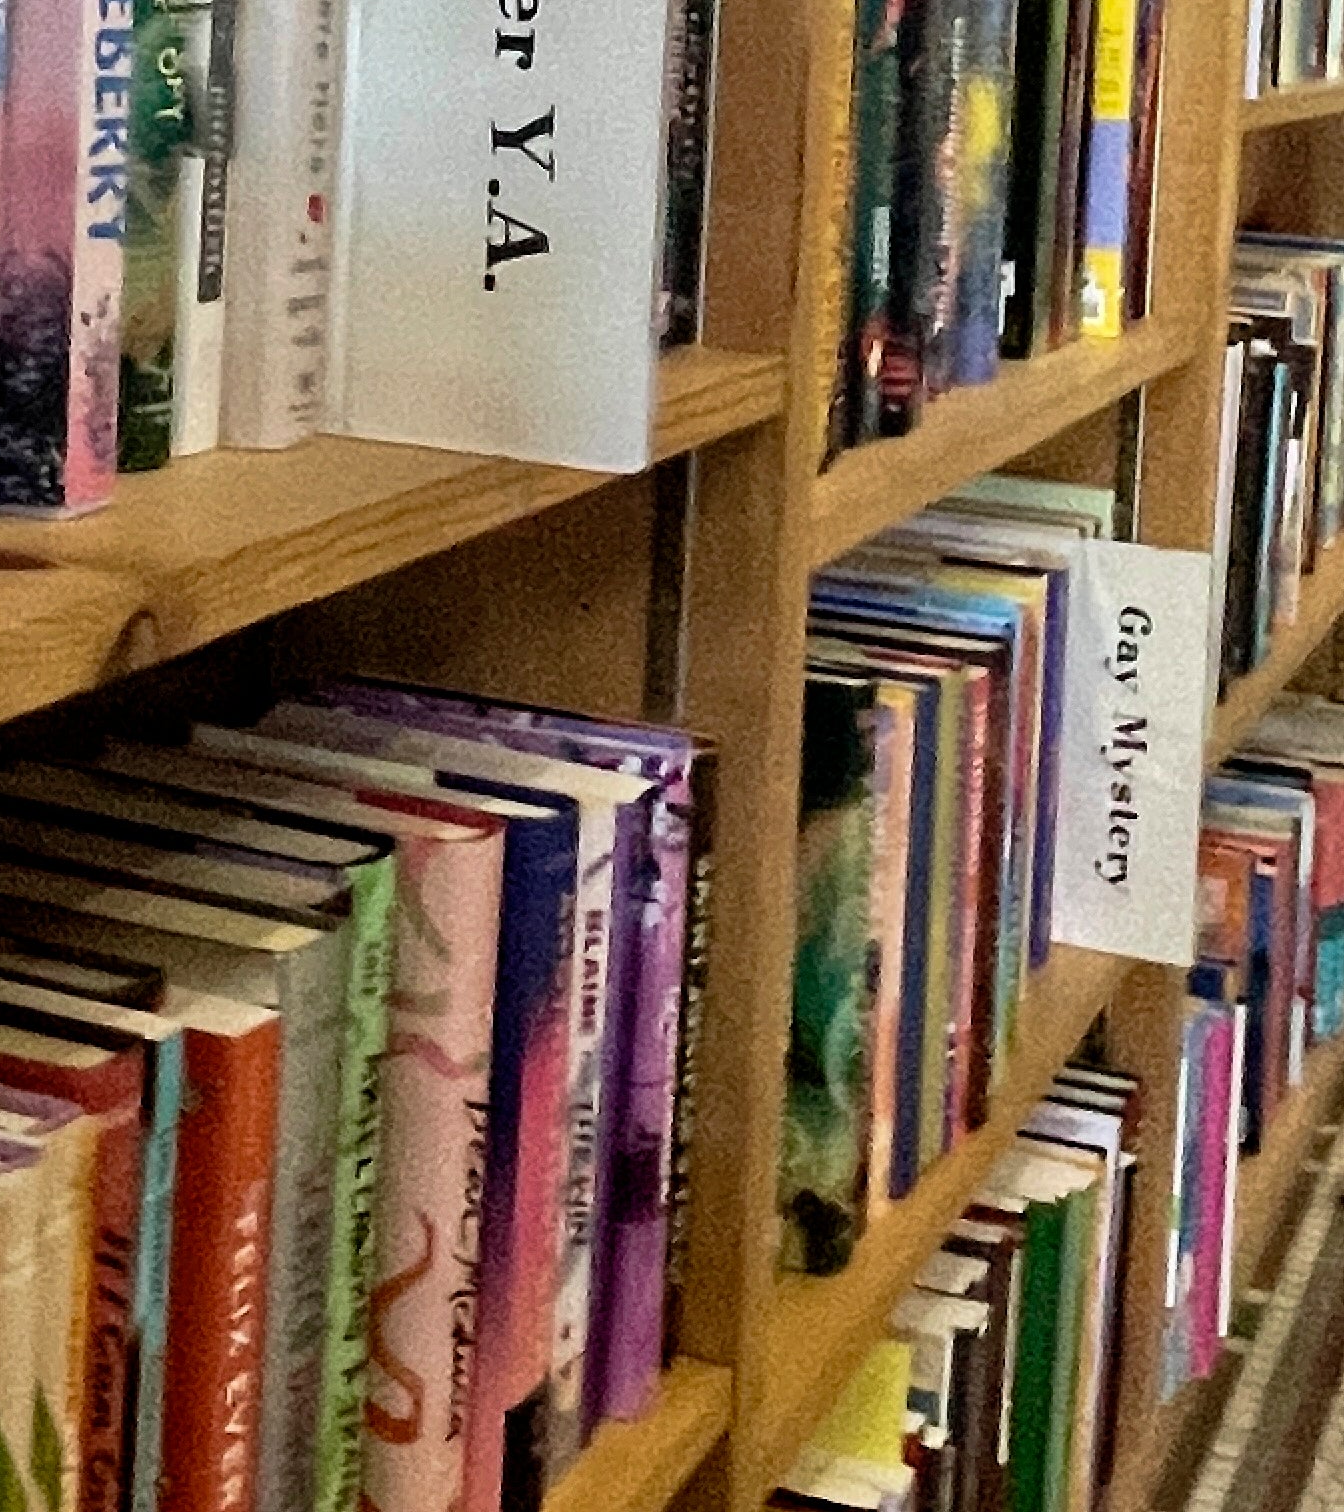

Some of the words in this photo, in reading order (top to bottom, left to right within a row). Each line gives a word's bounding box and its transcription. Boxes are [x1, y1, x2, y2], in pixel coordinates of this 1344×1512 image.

[482, 105, 557, 294] Y.A.
[1104, 605, 1154, 695] Gay
[1094, 710, 1149, 893] Mystery
